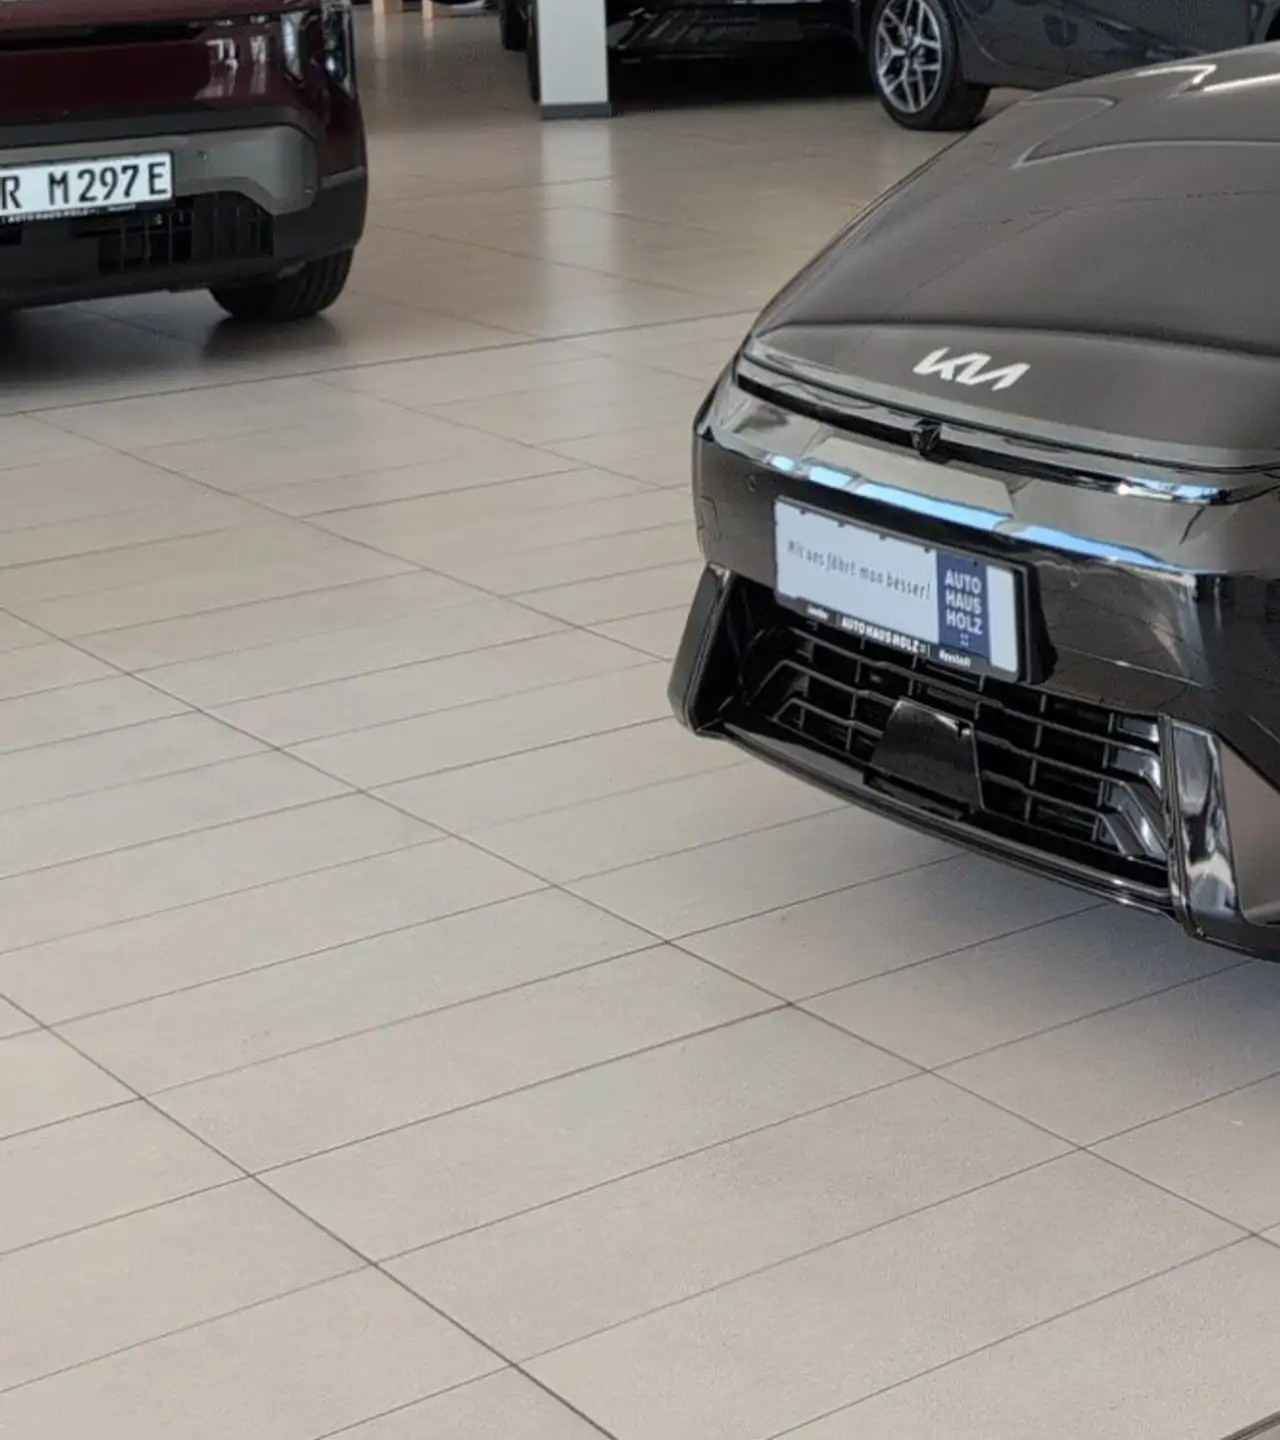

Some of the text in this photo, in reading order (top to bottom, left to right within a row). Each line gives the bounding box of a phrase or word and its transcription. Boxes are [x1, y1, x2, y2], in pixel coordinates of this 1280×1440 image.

[912, 346, 1032, 392] KIA
[945, 568, 982, 594] AUTO
[946, 588, 982, 615] HAUS
[946, 608, 984, 636] HOLZ
